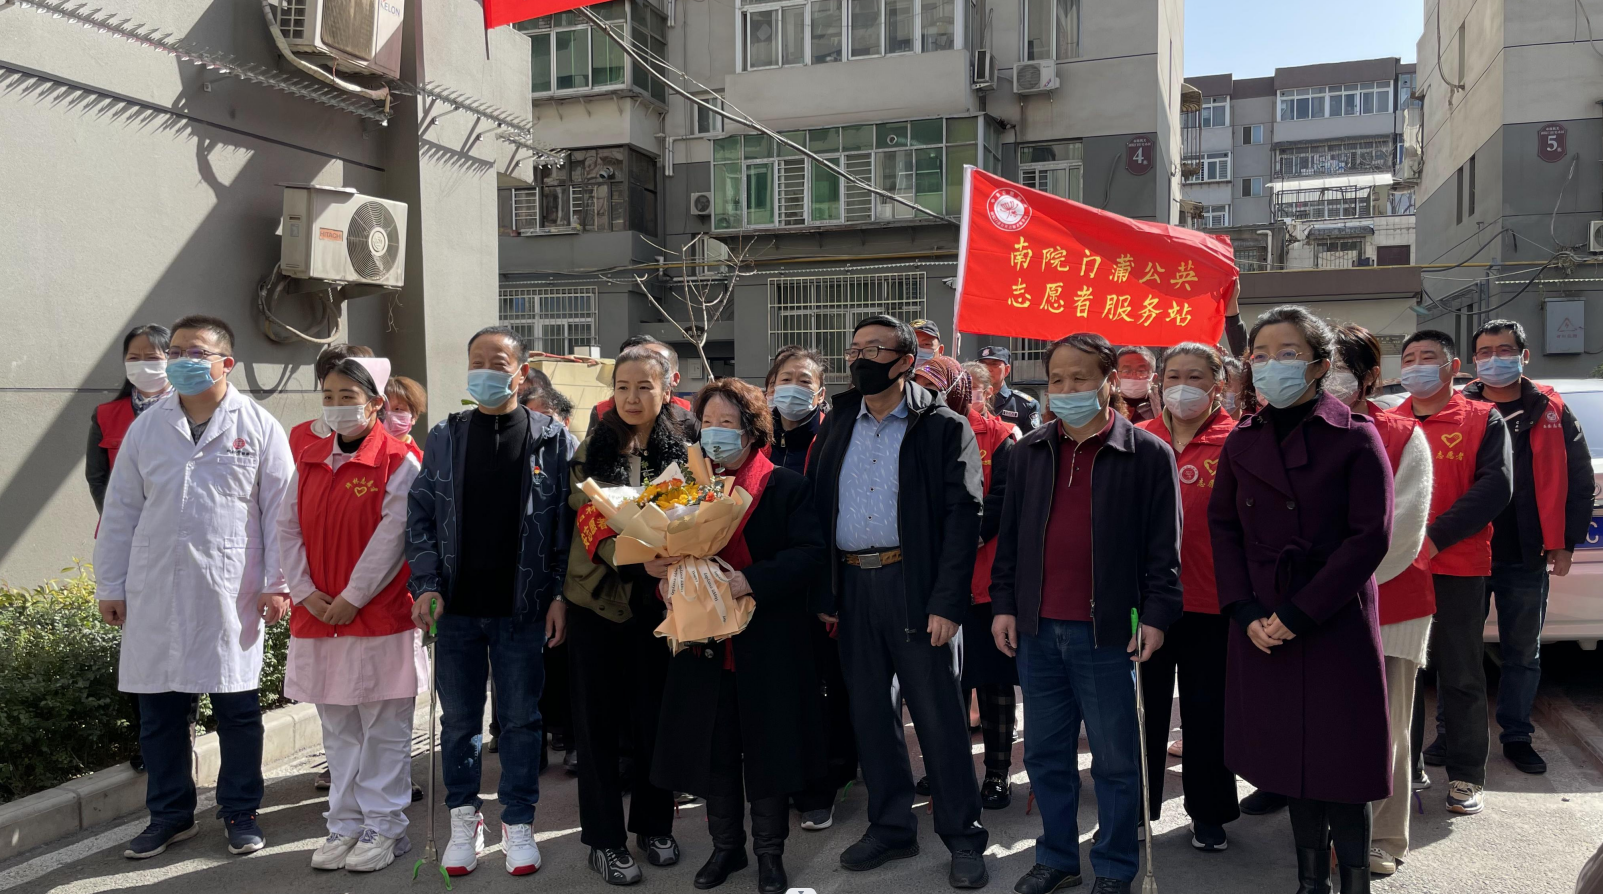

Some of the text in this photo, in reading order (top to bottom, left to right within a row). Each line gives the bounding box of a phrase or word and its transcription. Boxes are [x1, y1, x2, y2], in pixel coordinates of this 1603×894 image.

[1010, 236, 1198, 291] 南院门蒲公英
[1008, 278, 1192, 327] 志愿者服务站
